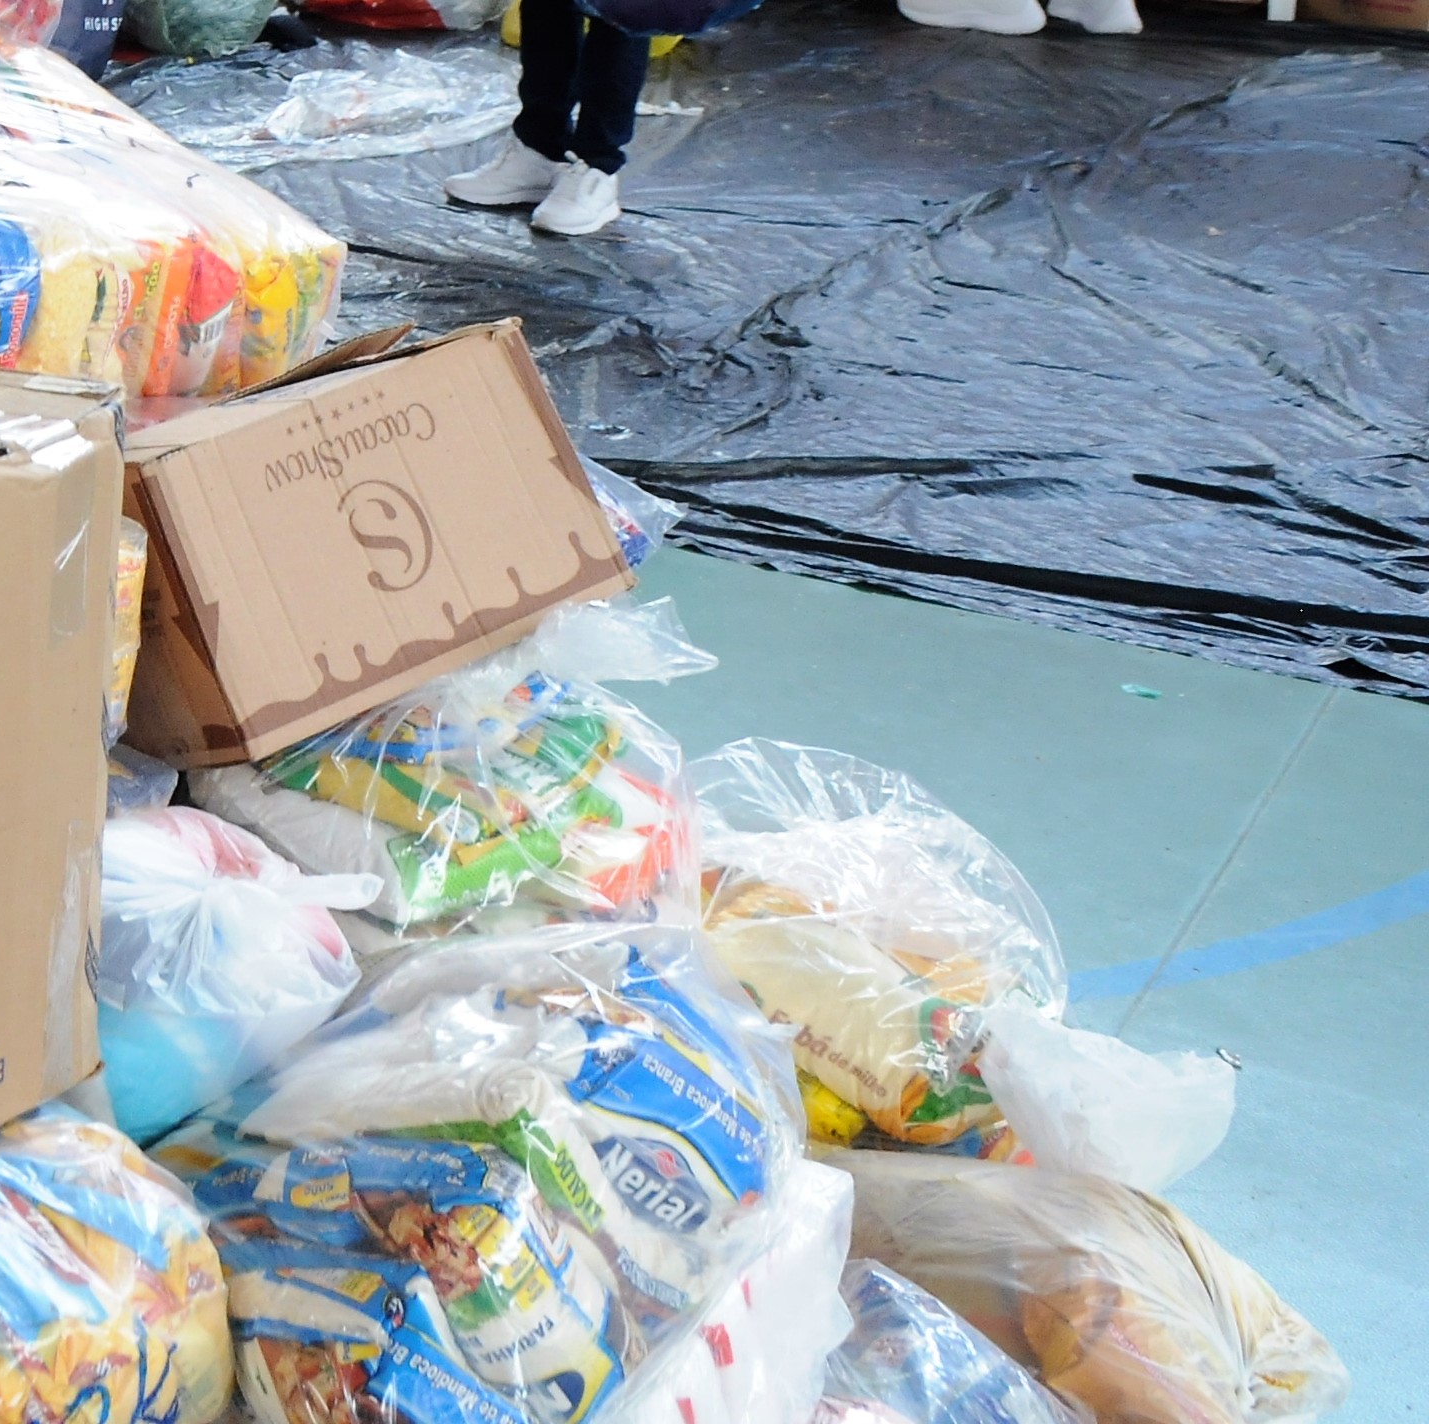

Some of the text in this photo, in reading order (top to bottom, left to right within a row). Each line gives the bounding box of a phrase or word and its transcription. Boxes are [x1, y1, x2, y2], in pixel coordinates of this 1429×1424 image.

[84, 16, 110, 32] HIGH
[642, 1052, 685, 1097] Branca
[601, 1141, 703, 1230] Nerial
